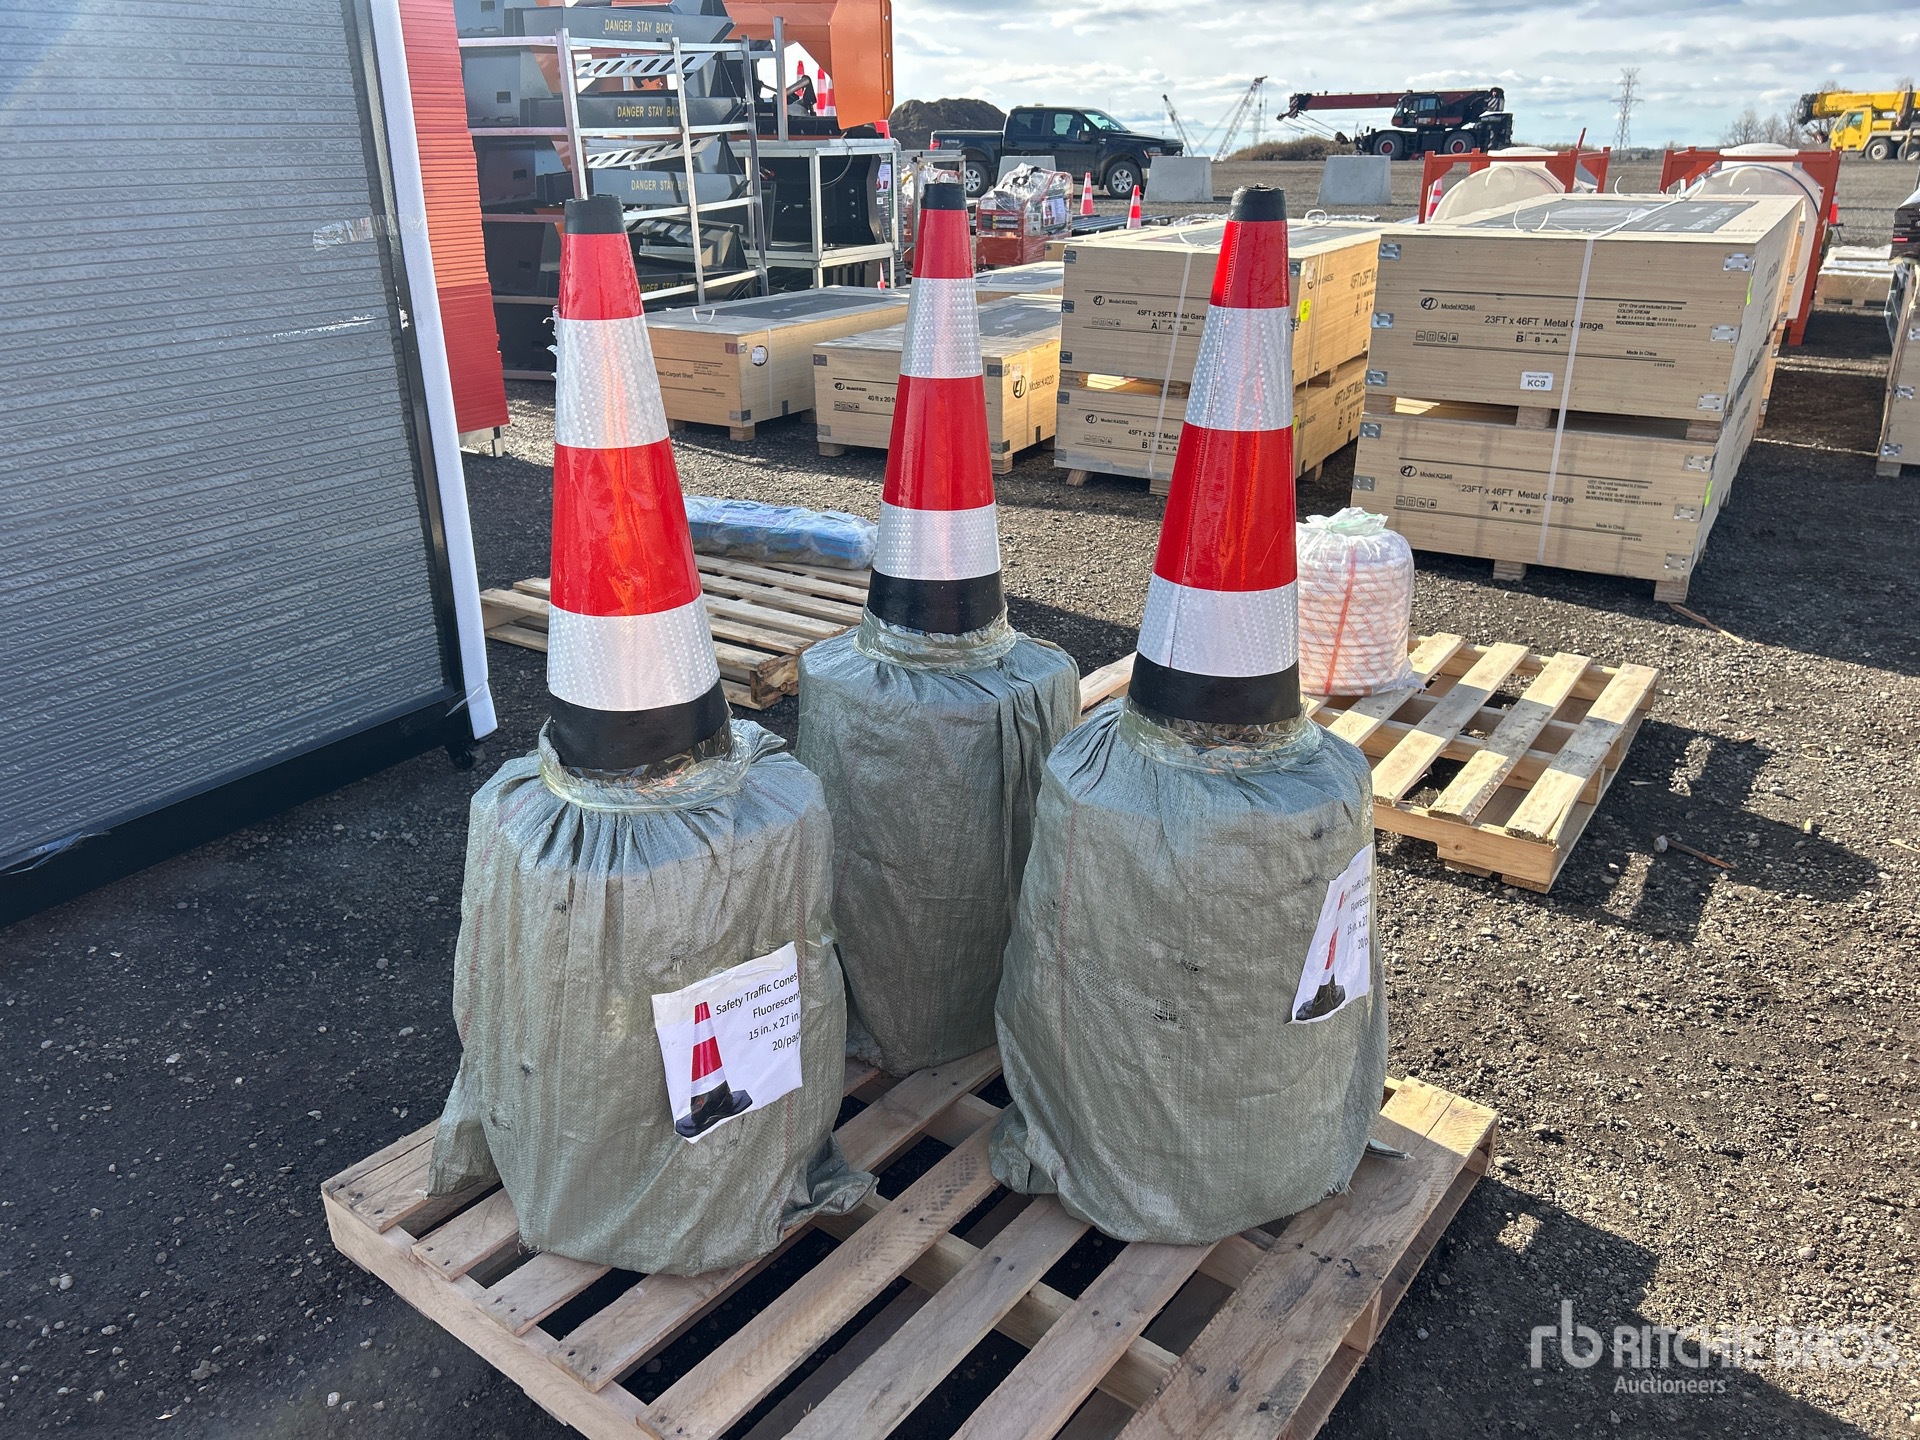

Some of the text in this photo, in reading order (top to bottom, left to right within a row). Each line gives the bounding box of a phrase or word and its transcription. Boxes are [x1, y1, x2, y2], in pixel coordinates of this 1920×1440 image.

[604, 19, 672, 34] DANGER STAY BACK
[618, 106, 680, 118] DANGER STAY BAC
[631, 180, 656, 191] DANGER
[660, 180, 674, 191] STAY
[1157, 310, 1172, 318] 25FT
[1190, 313, 1206, 321] Gara
[1151, 322, 1158, 330] A
[1484, 315, 1508, 324] 23FT
[1516, 317, 1540, 326] 46FT
[1544, 318, 1568, 328] Metal
[1516, 334, 1524, 342] B
[1528, 380, 1546, 388] KC9
[1163, 432, 1178, 440] Metal
[1462, 484, 1483, 493] 23FT
[1492, 488, 1514, 496] 46FT
[1518, 490, 1540, 500] Metal
[1492, 504, 1498, 512] A
[716, 972, 798, 1015] Safety Traffic Cones
[752, 990, 800, 1018] Fluorescent
[748, 1028, 758, 1040] 15
[760, 1026, 772, 1036] in.
[772, 1022, 778, 1030] x
[780, 1014, 790, 1028] 27
